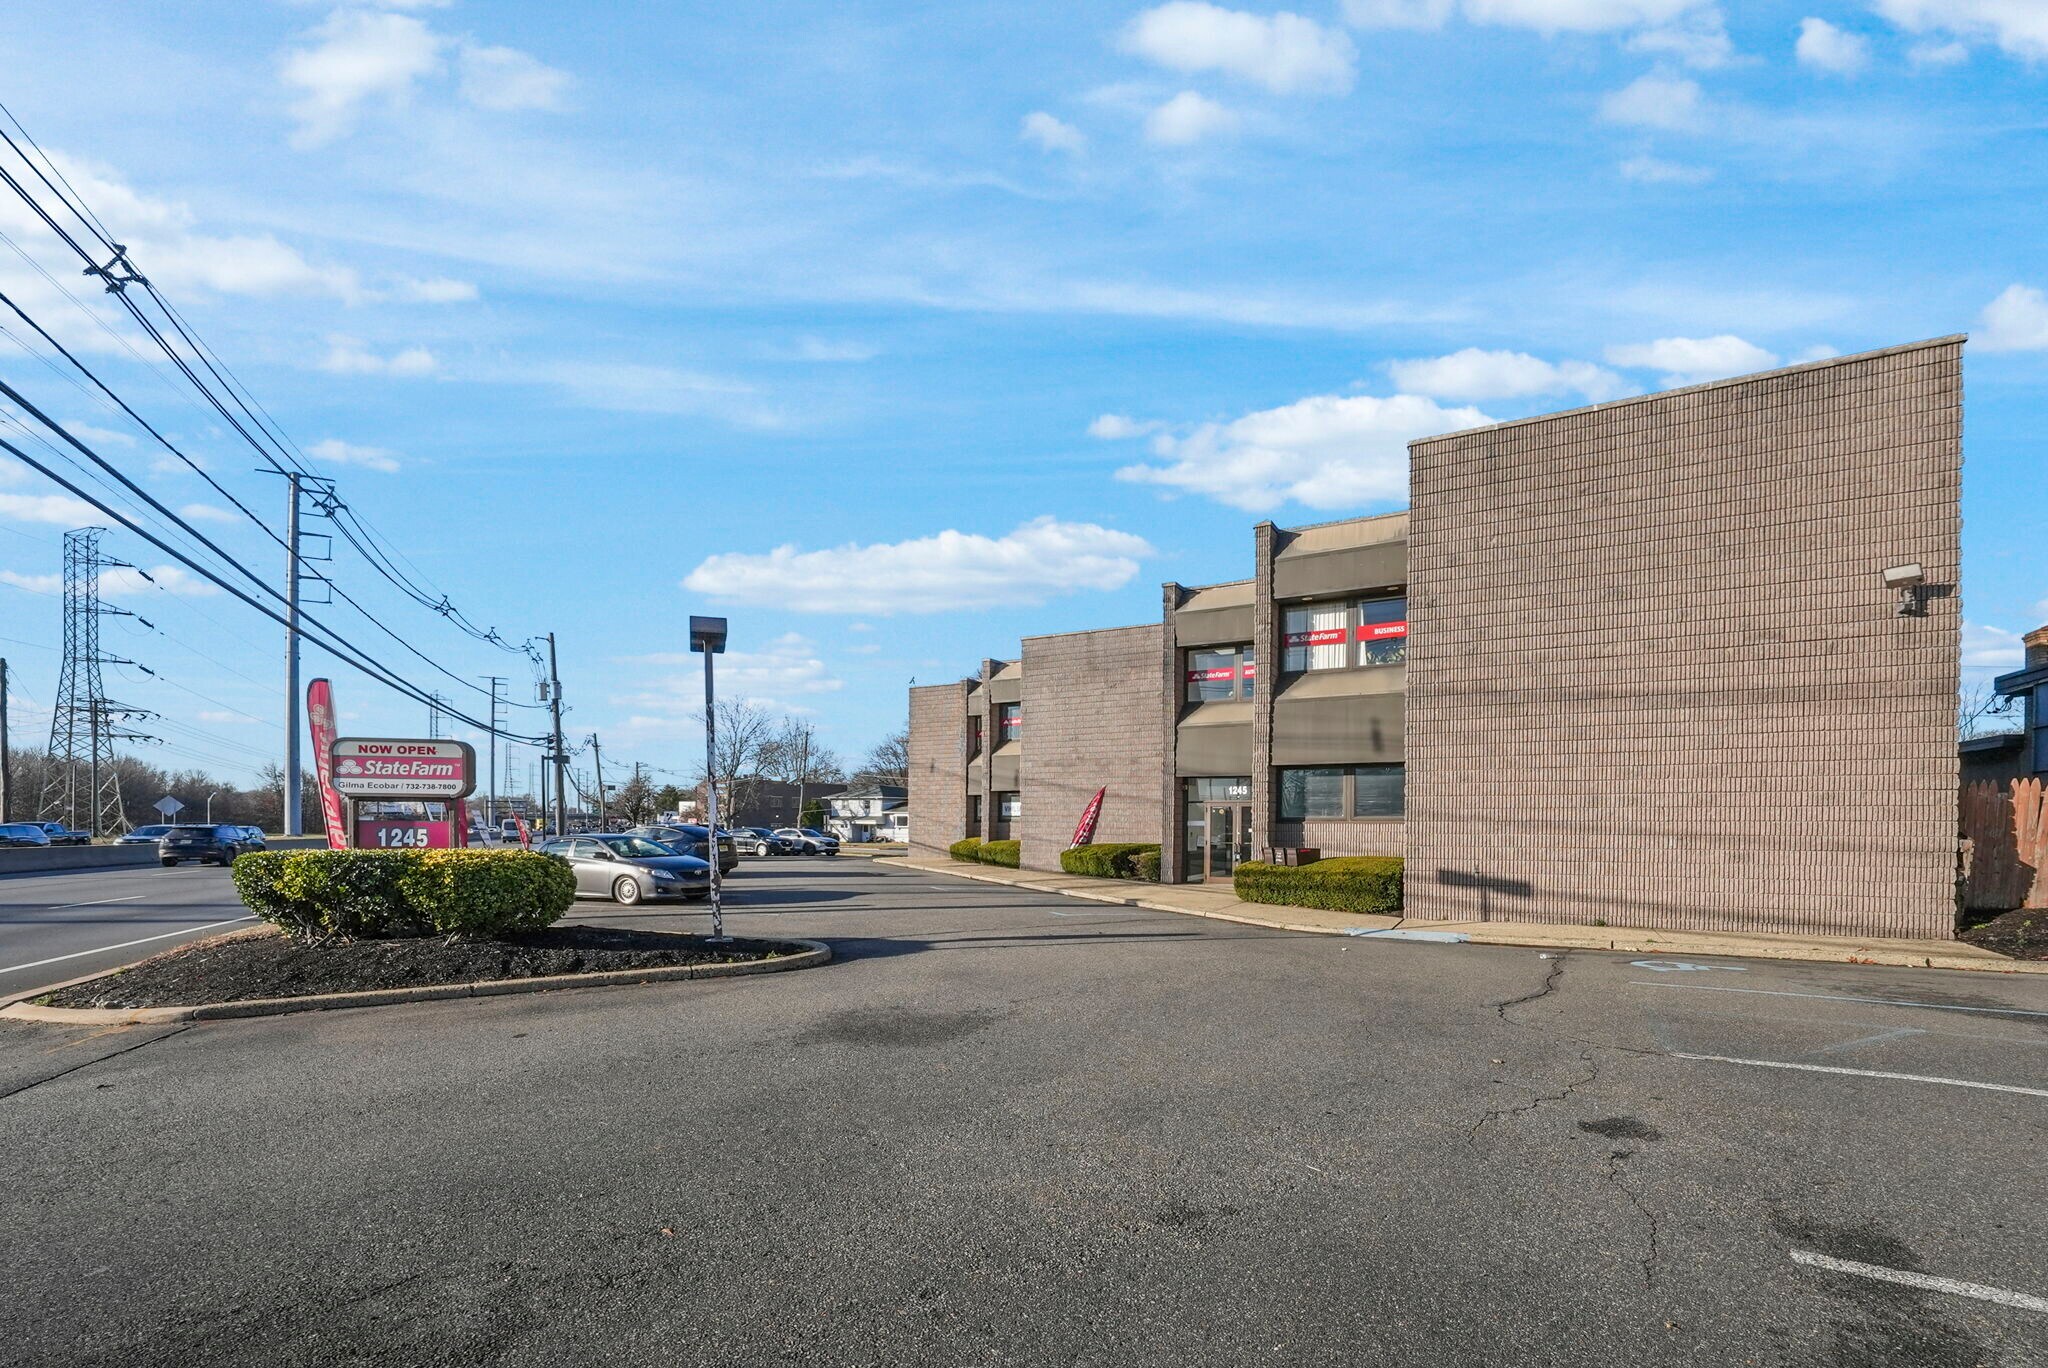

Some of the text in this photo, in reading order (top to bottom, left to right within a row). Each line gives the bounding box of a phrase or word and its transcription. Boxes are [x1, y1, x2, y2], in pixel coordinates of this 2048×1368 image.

[1374, 626, 1405, 635] BUSINESS
[358, 744, 437, 755] NOW OPEN
[338, 781, 365, 789] Gilma
[1228, 785, 1248, 795] 1245
[378, 828, 428, 847] 1245
